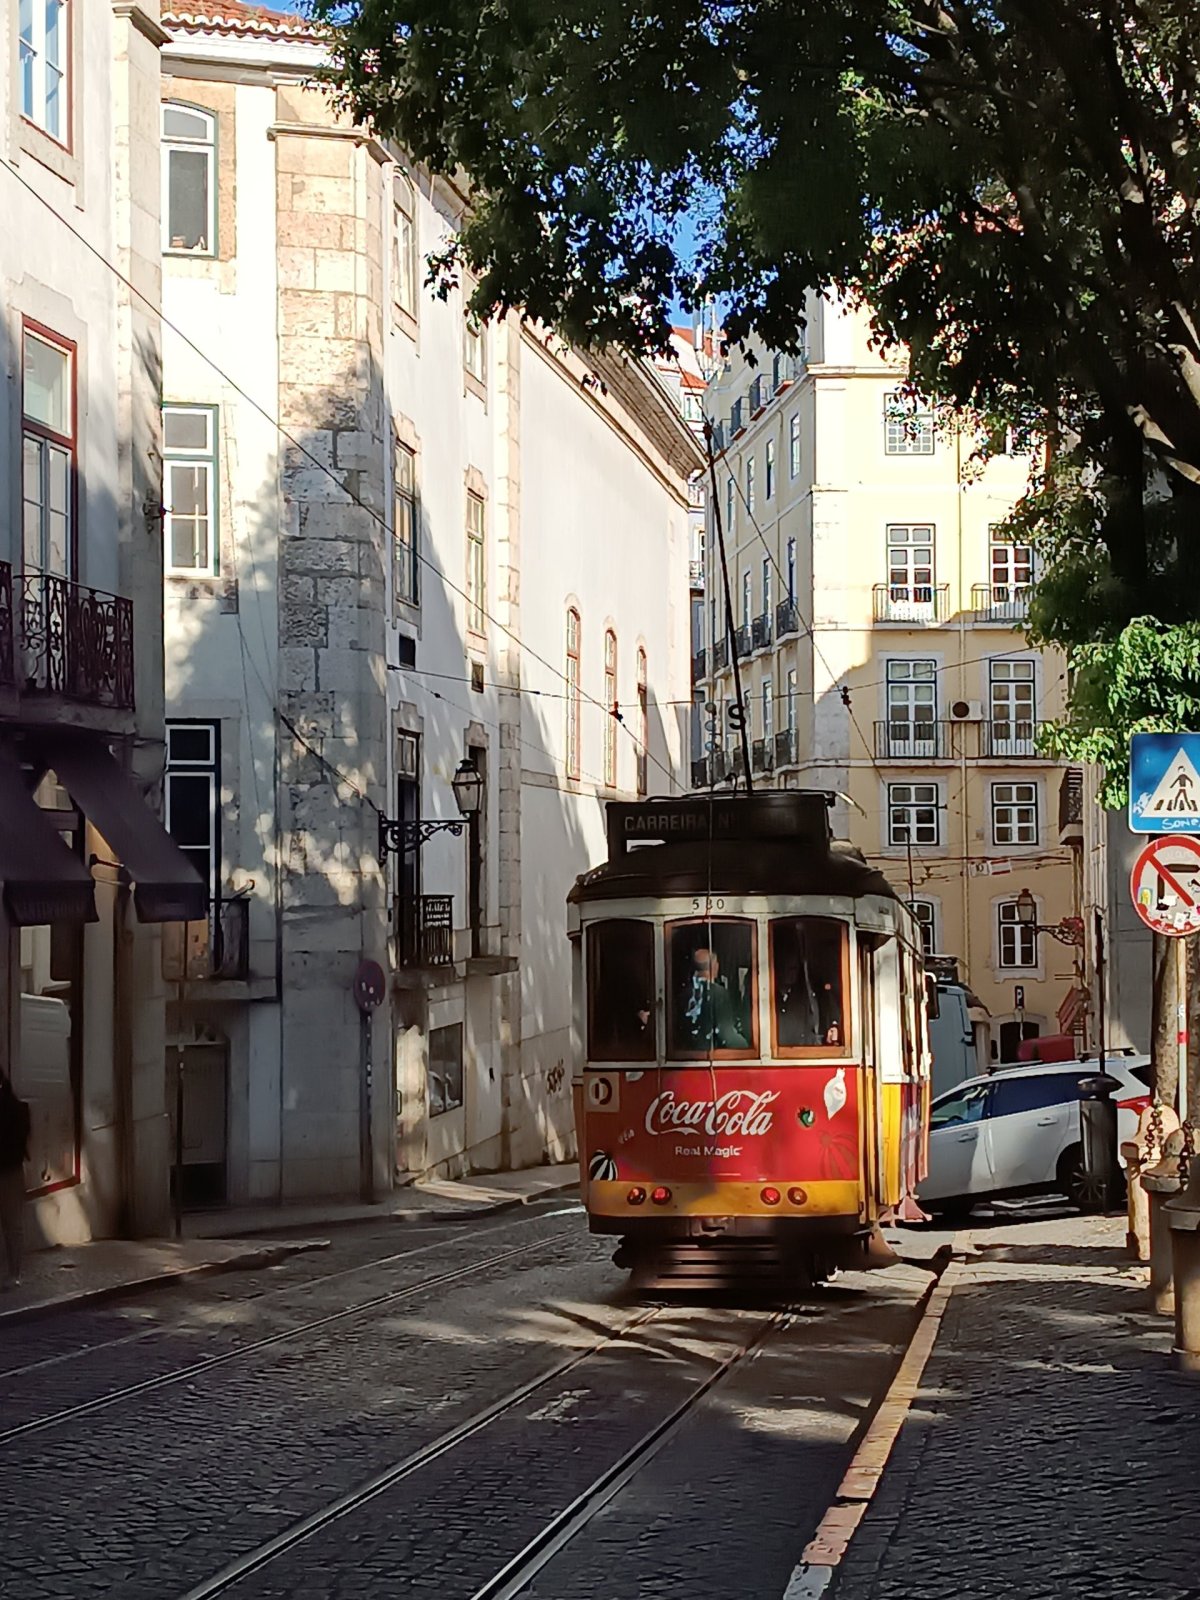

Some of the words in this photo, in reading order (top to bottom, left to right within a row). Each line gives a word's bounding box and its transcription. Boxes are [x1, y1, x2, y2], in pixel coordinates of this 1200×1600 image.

[624, 814, 707, 832] CARREIRA
[645, 1090, 782, 1136] Coca-Cola
[675, 1146, 701, 1156] Real
[704, 1145, 744, 1158] Magic
